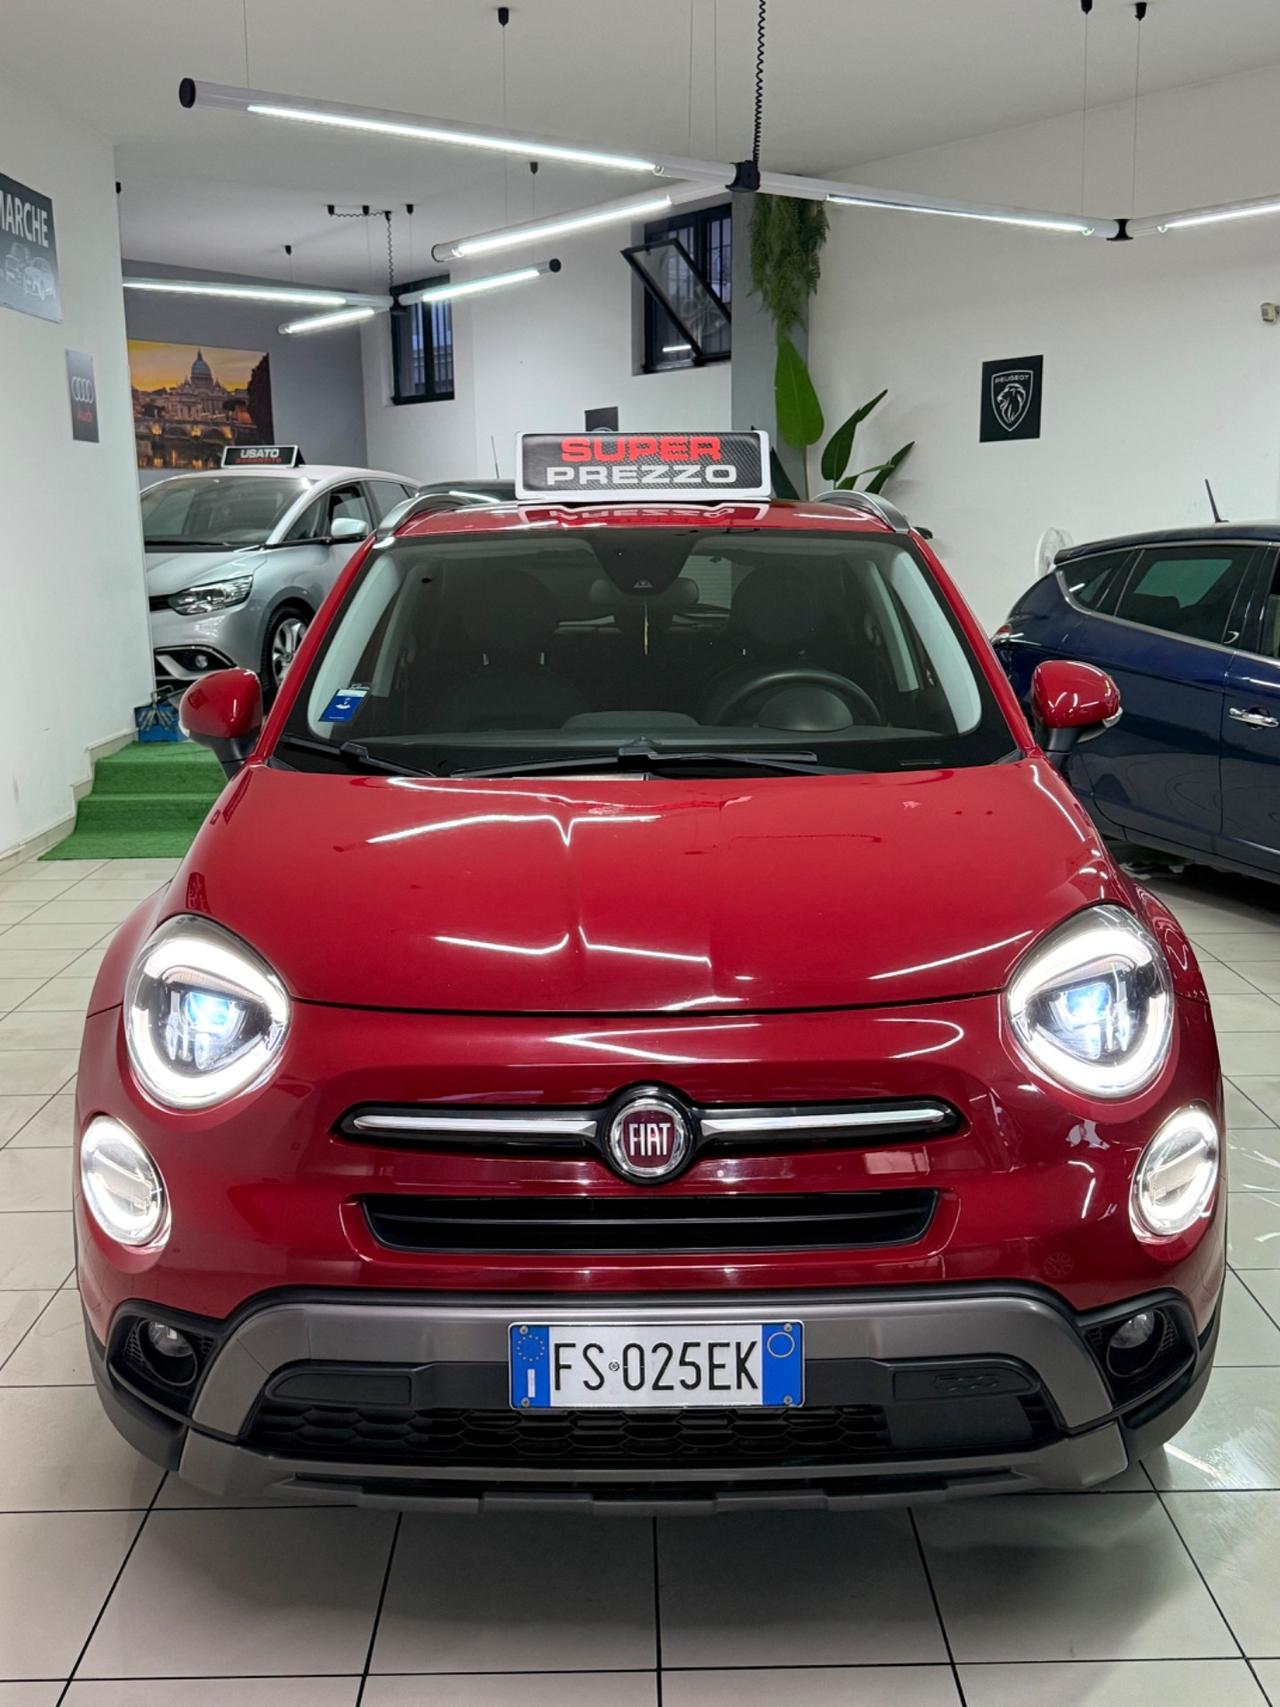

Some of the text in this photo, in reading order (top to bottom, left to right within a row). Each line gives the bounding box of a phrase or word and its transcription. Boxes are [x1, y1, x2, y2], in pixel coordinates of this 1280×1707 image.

[240, 449, 279, 458] USATO
[561, 436, 721, 462] SUPER
[547, 465, 737, 485] PREZZO
[629, 1123, 671, 1156] FIAT
